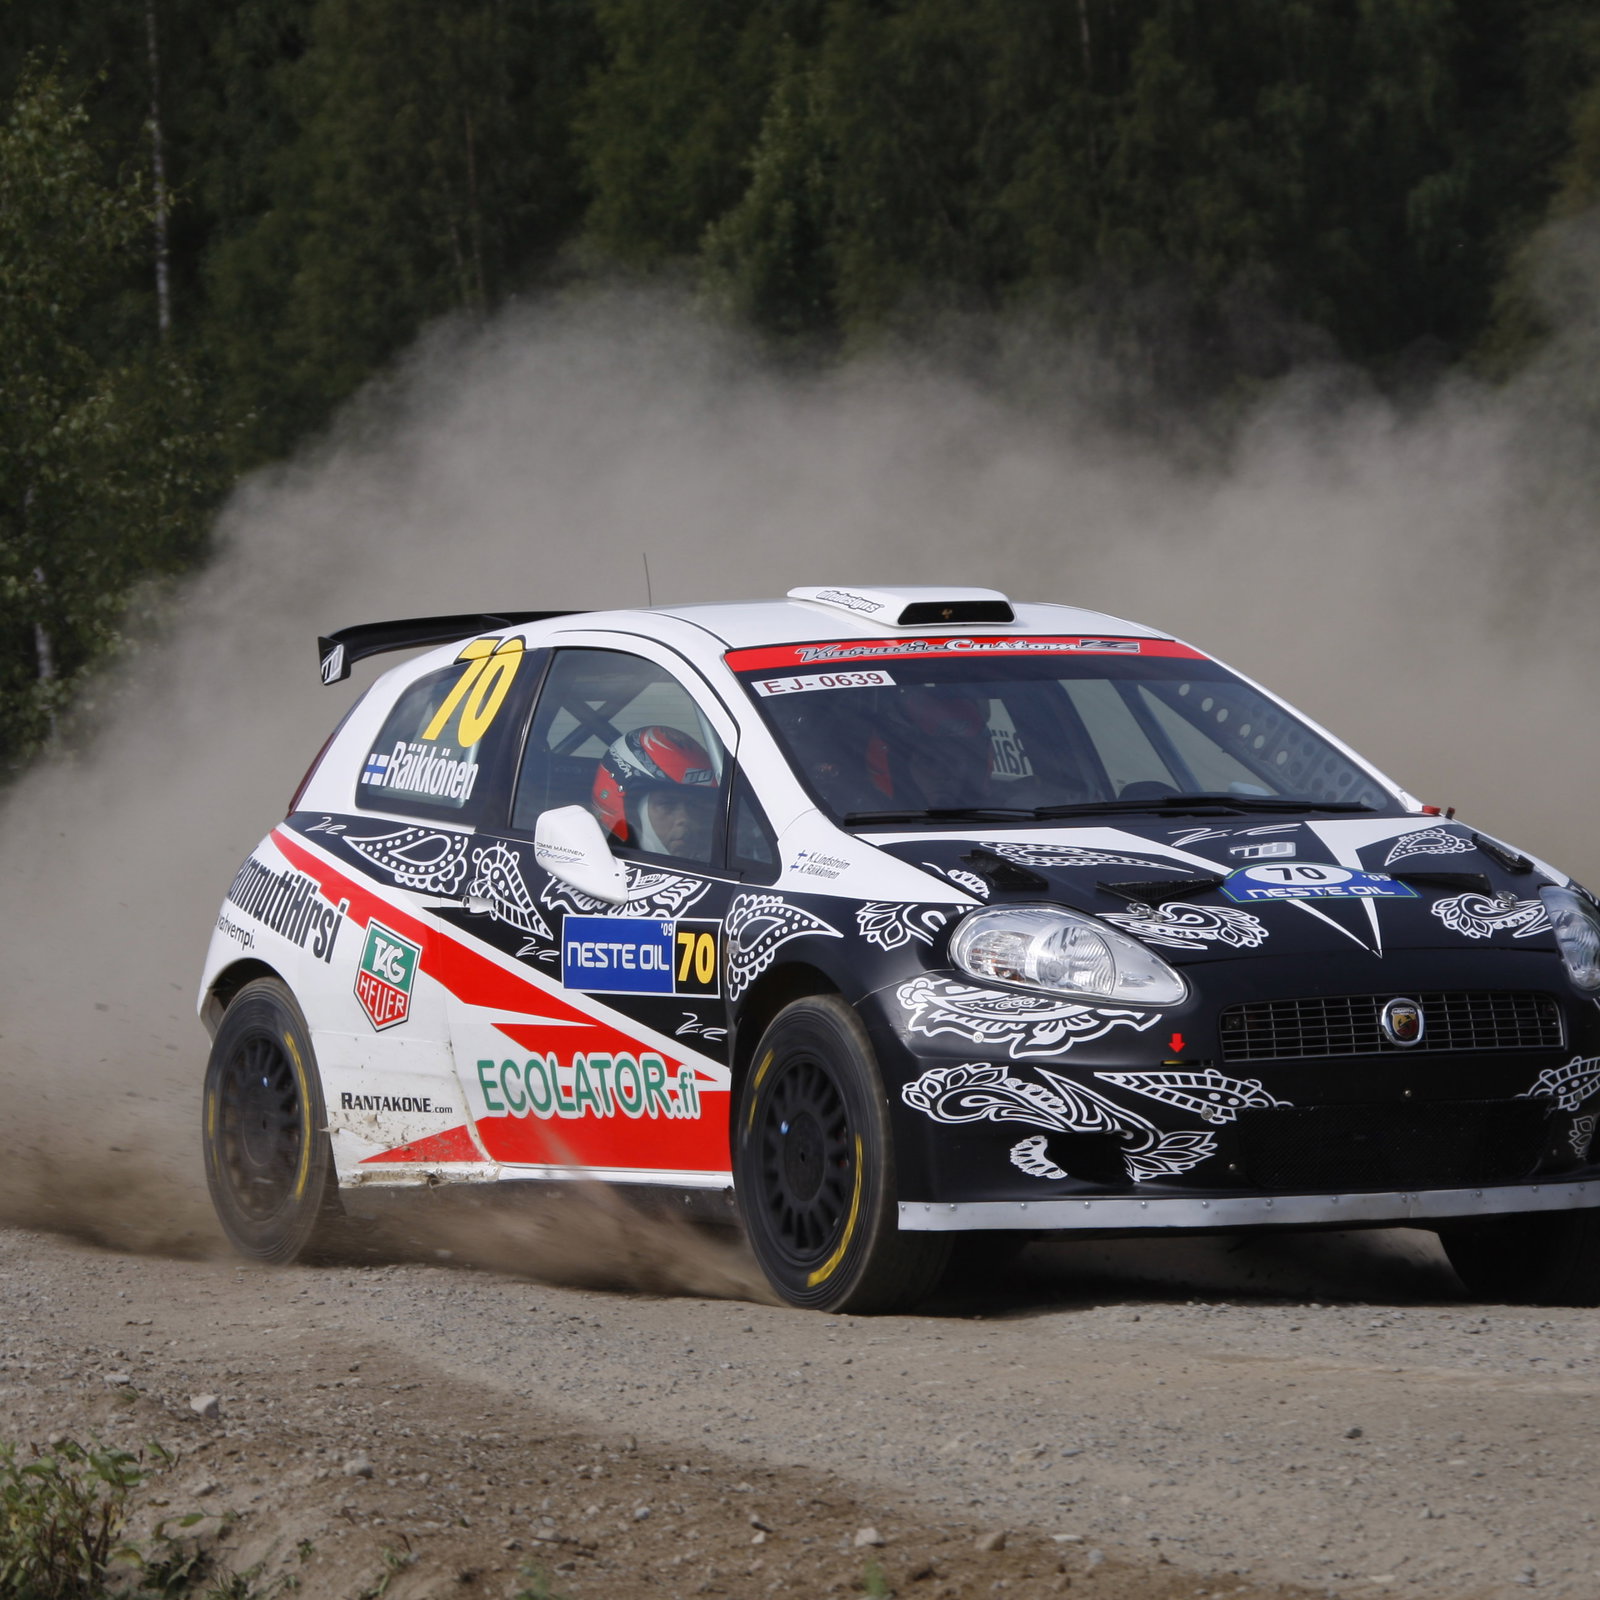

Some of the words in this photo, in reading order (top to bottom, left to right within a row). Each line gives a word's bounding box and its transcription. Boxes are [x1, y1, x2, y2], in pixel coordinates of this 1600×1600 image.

[421, 636, 526, 748] 70
[382, 741, 479, 800] Räikkönen
[1246, 886, 1345, 899] NESTE
[1348, 886, 1395, 896] OIL
[1266, 867, 1327, 881] 70
[660, 922, 674, 937] '09
[372, 937, 406, 984] TAG
[567, 941, 636, 970] NESTE
[639, 944, 670, 971] OIL
[677, 932, 715, 984] 70
[360, 975, 405, 1022] HEUER
[477, 1058, 698, 1113] ECOLATOR.fi
